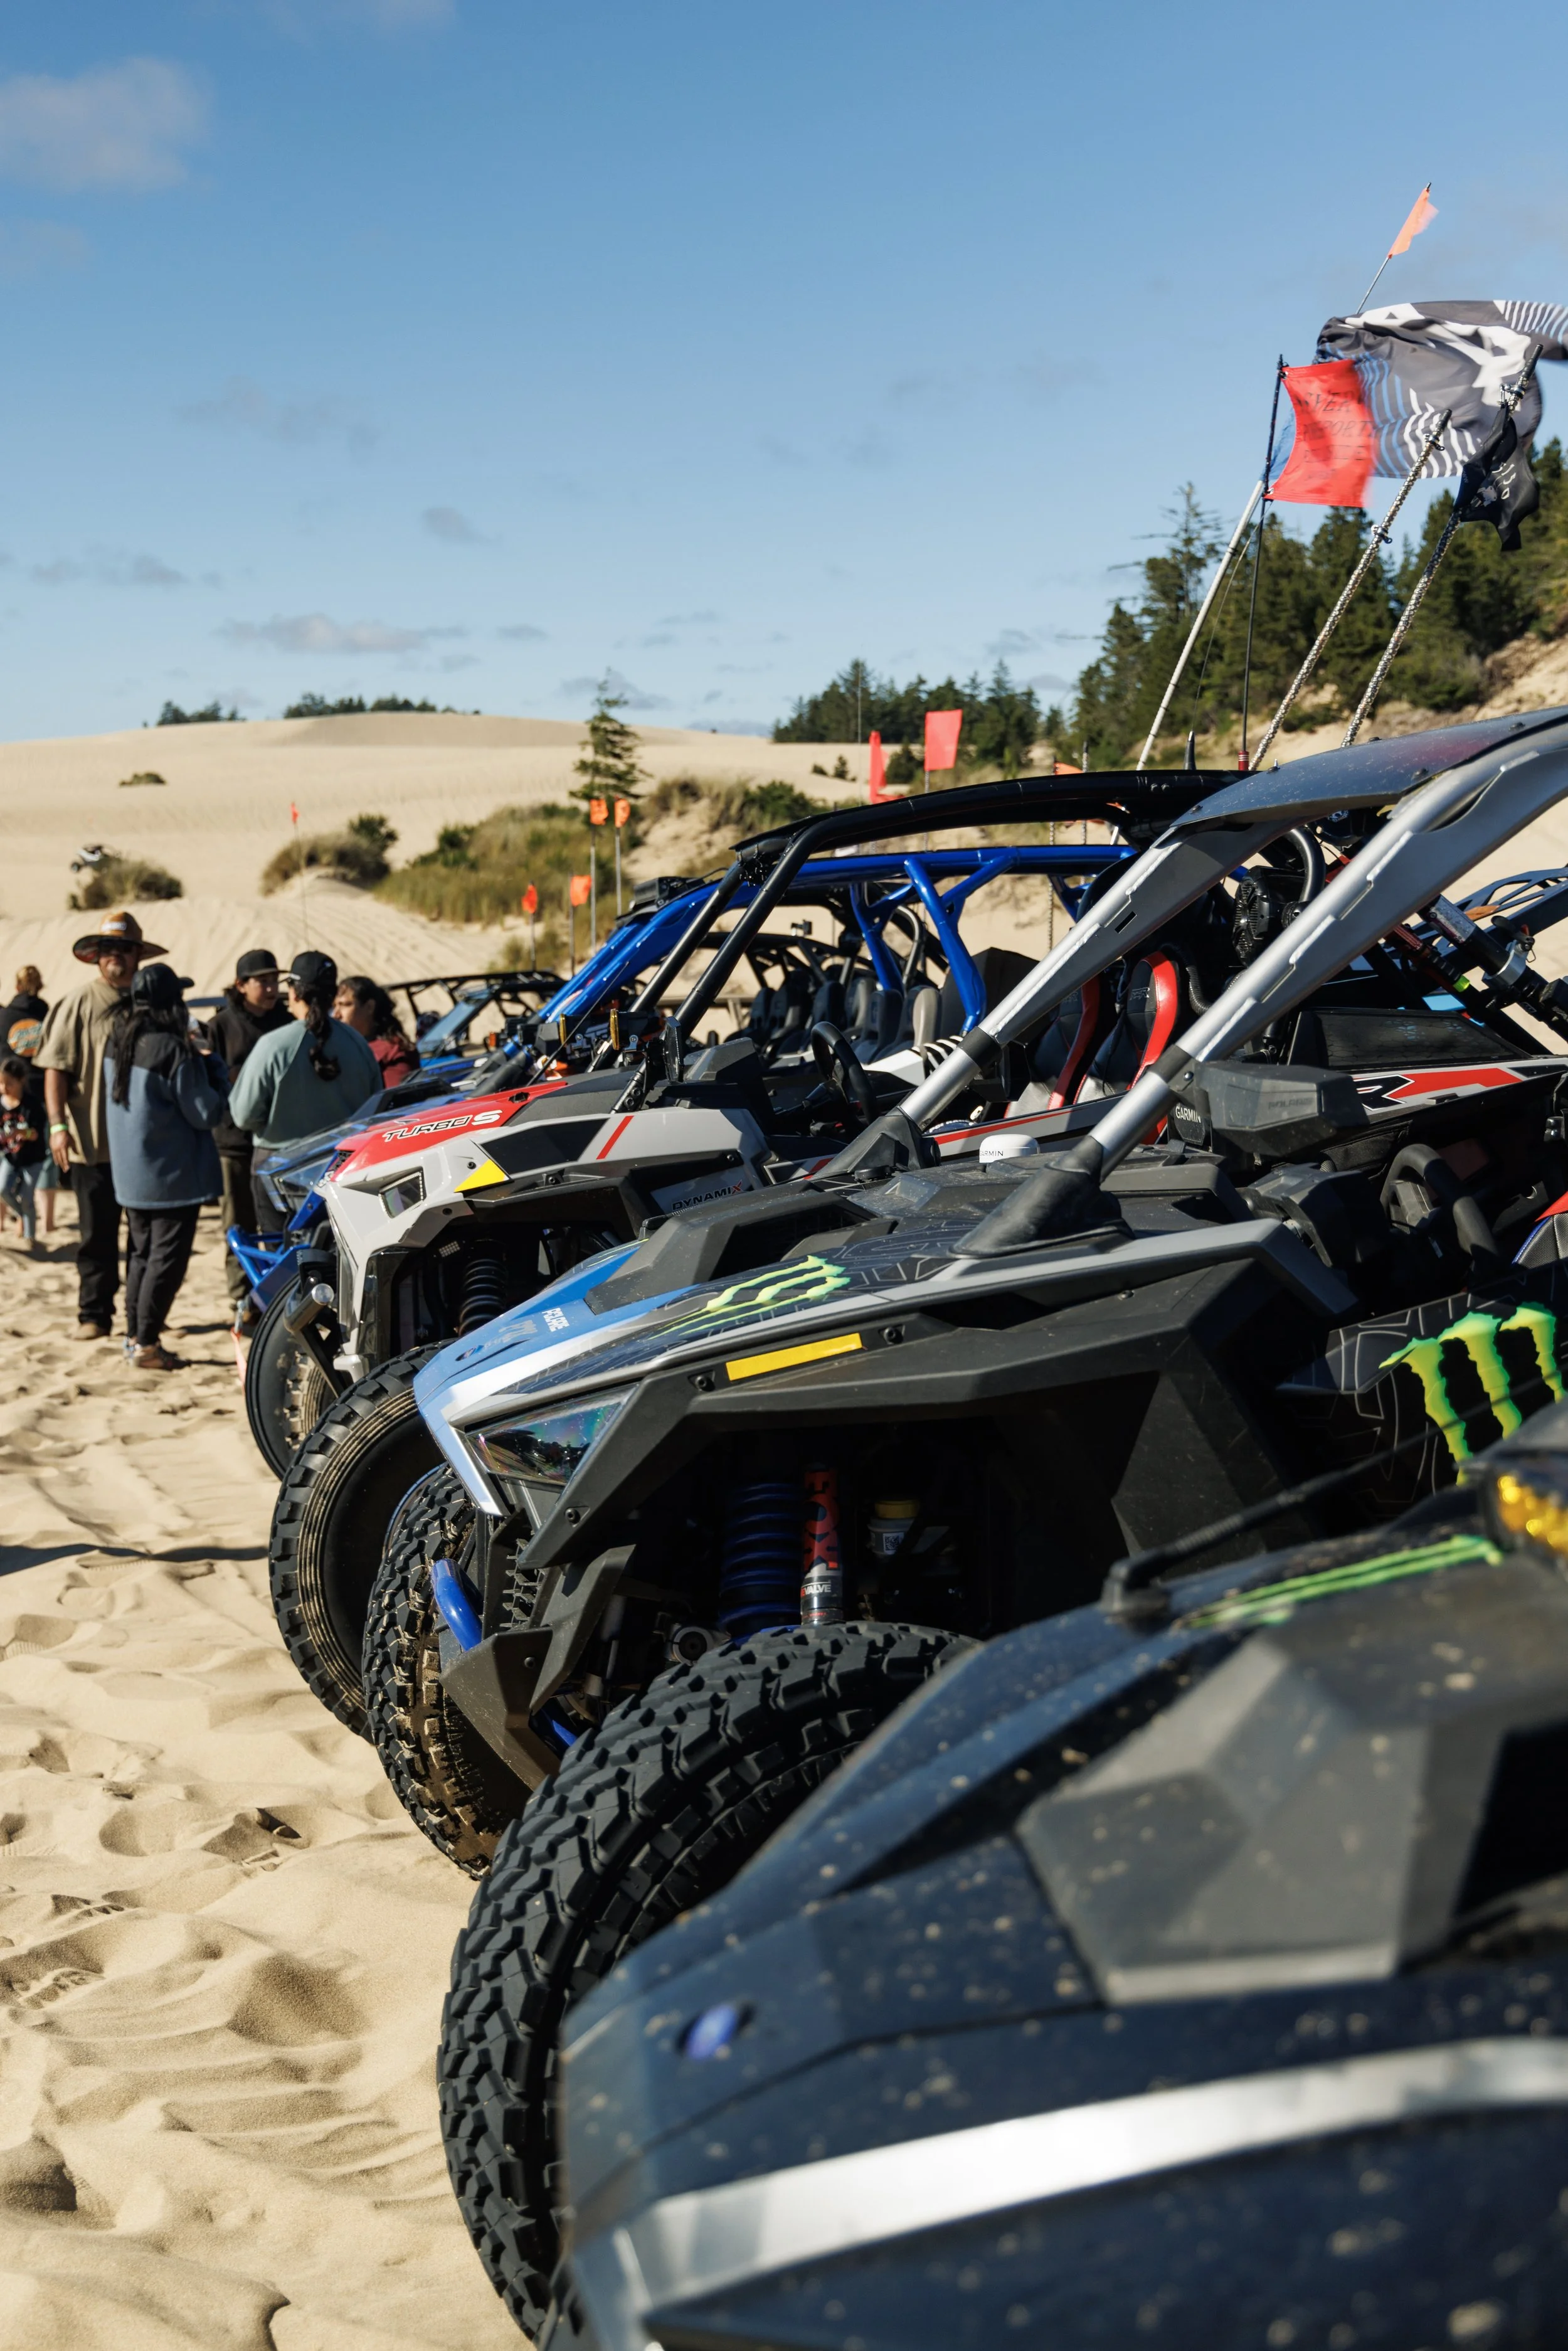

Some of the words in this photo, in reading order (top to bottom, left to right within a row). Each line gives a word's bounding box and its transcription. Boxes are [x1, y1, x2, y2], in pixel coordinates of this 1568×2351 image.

[382, 1115, 473, 1142] TURBO
[472, 1110, 502, 1125] S
[1175, 1106, 1201, 1123] GARMIN
[672, 1179, 743, 1211] DYNAMIX
[804, 1471, 839, 1572] FOX
